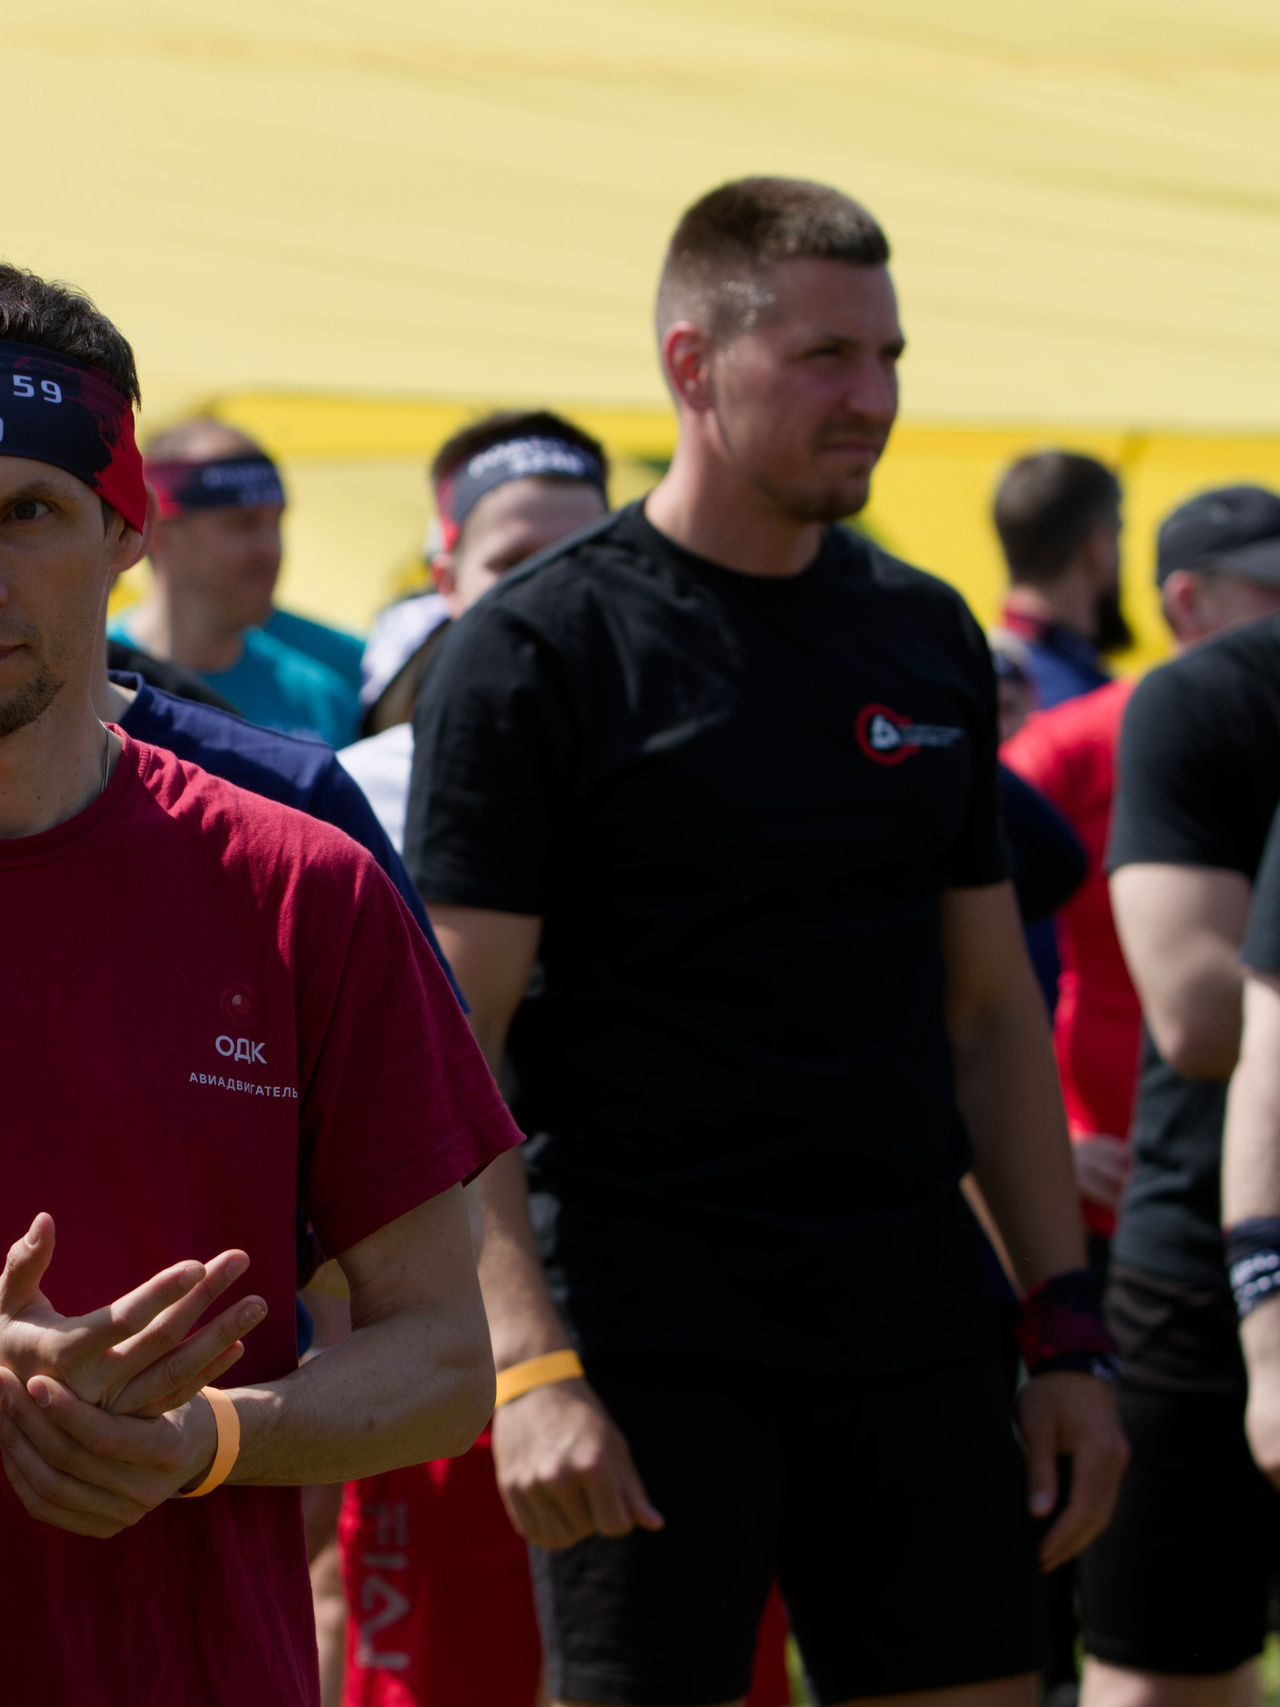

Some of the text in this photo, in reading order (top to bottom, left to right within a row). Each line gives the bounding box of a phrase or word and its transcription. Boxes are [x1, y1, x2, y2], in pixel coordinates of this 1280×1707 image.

[12, 374, 63, 404] 59
[214, 1034, 268, 1065] ОДК
[188, 1071, 299, 1099] АВИАДВИГАТЕЛЬ
